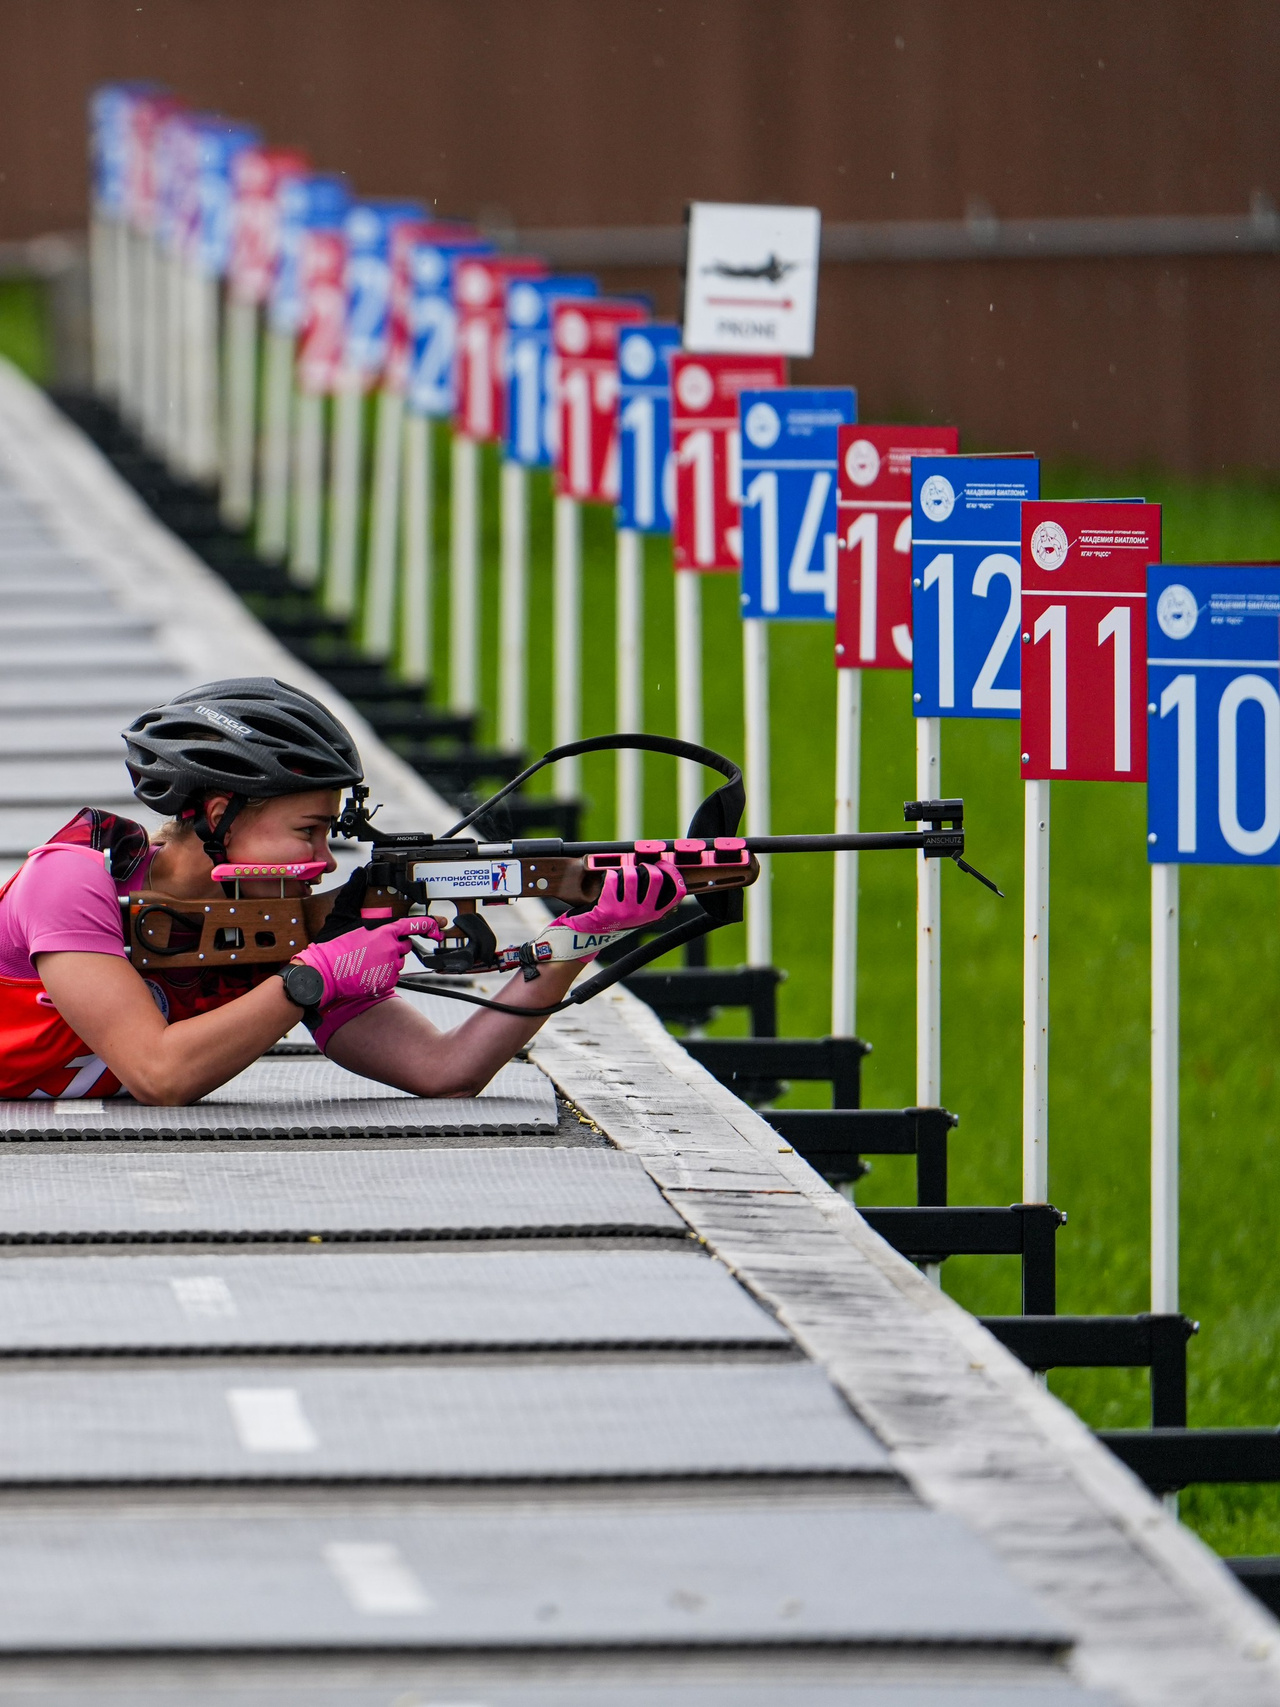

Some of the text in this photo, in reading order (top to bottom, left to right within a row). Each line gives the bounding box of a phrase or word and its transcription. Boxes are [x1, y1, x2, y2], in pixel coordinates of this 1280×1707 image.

[745, 471, 836, 613] 14
[1078, 536, 1149, 545] "АКАДЕМИЯ БИАТЛОНА"
[923, 553, 1021, 709] 12
[1033, 605, 1131, 771] 11
[1160, 673, 1280, 856] 10
[416, 875, 490, 883] БИАТЛОНИСТОВ
